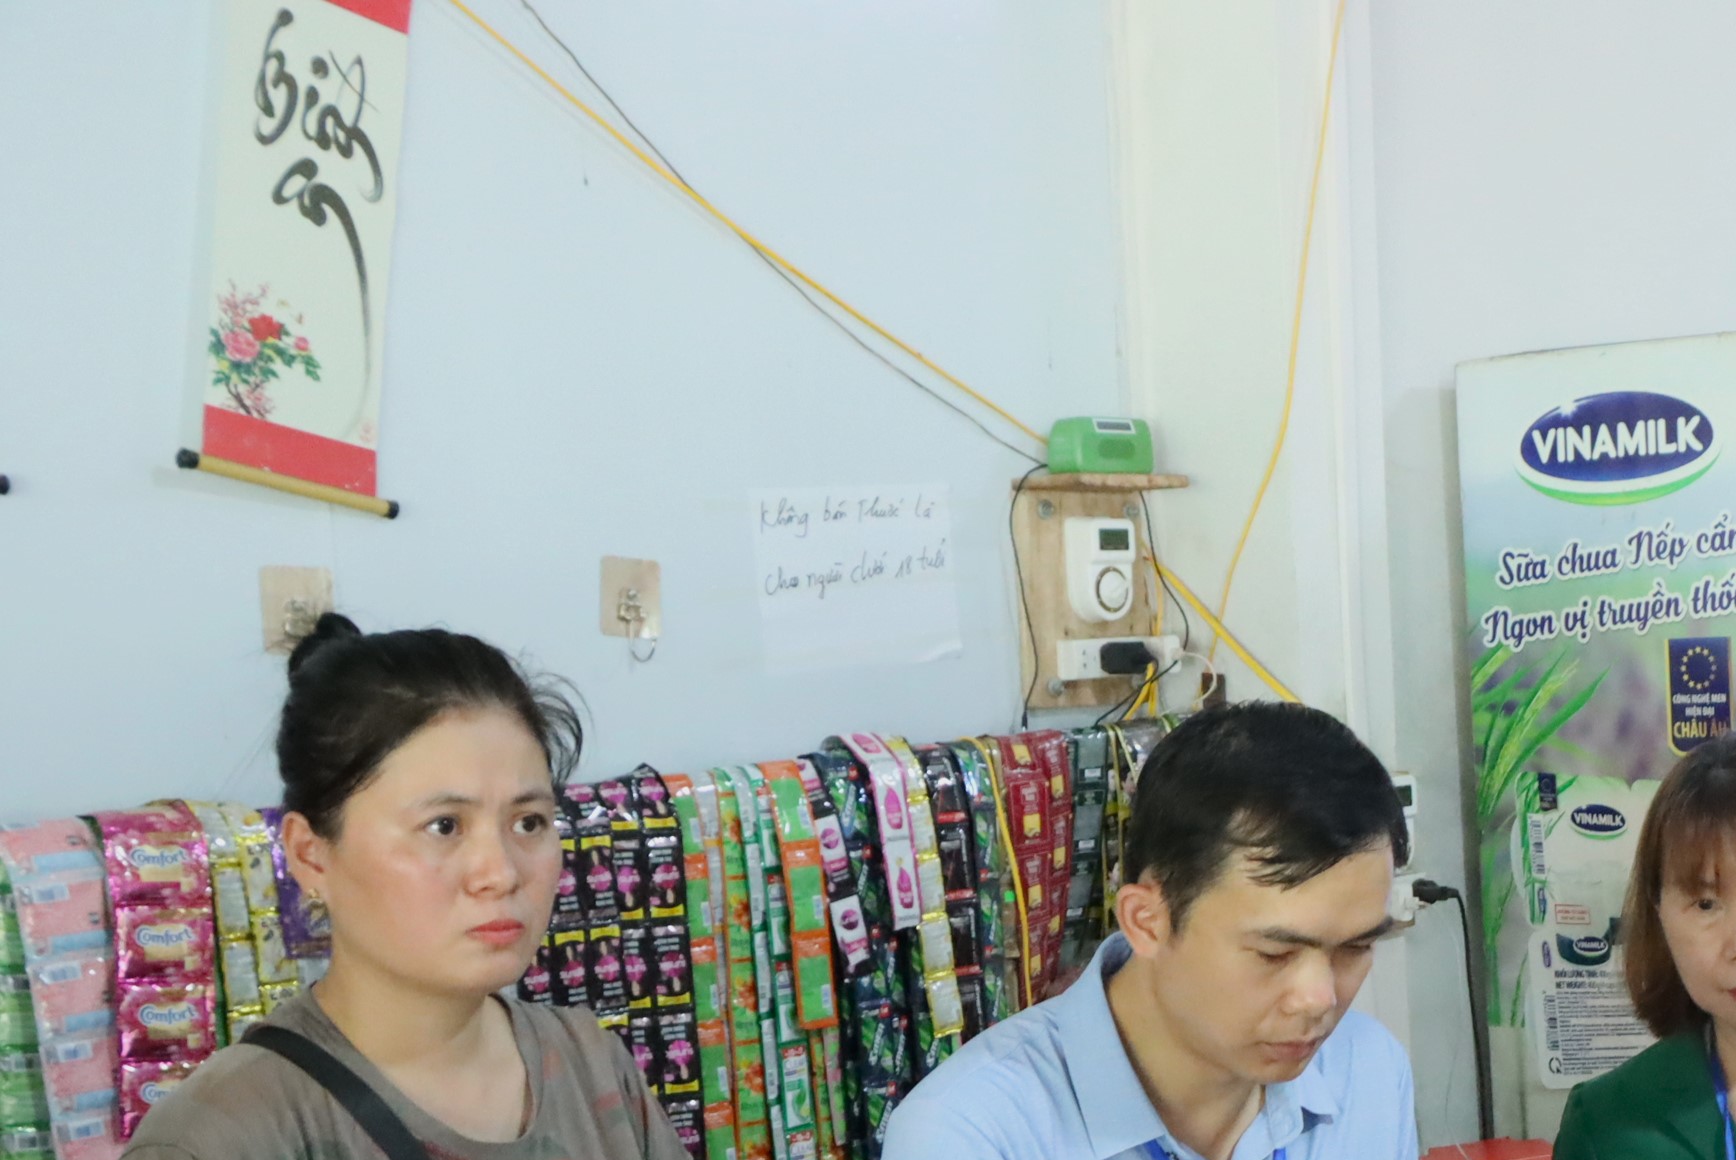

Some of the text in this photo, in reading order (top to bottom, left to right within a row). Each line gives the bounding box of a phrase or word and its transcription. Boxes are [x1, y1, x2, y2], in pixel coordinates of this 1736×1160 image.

[1531, 415, 1704, 465] VINAMILK
[1499, 551, 1548, 586] Sữa
[1557, 542, 1618, 576] chua
[1628, 522, 1687, 565] Nếp
[895, 555, 913, 579] 18
[1484, 609, 1556, 649] Ngon
[1564, 600, 1590, 639] vị
[1597, 582, 1681, 632] truyền
[1673, 720, 1707, 739] CHÂU
[1573, 810, 1625, 828] VINAMILK
[130, 845, 187, 868] Comfort
[135, 924, 193, 948] Comfort
[139, 1003, 197, 1027] Comfort
